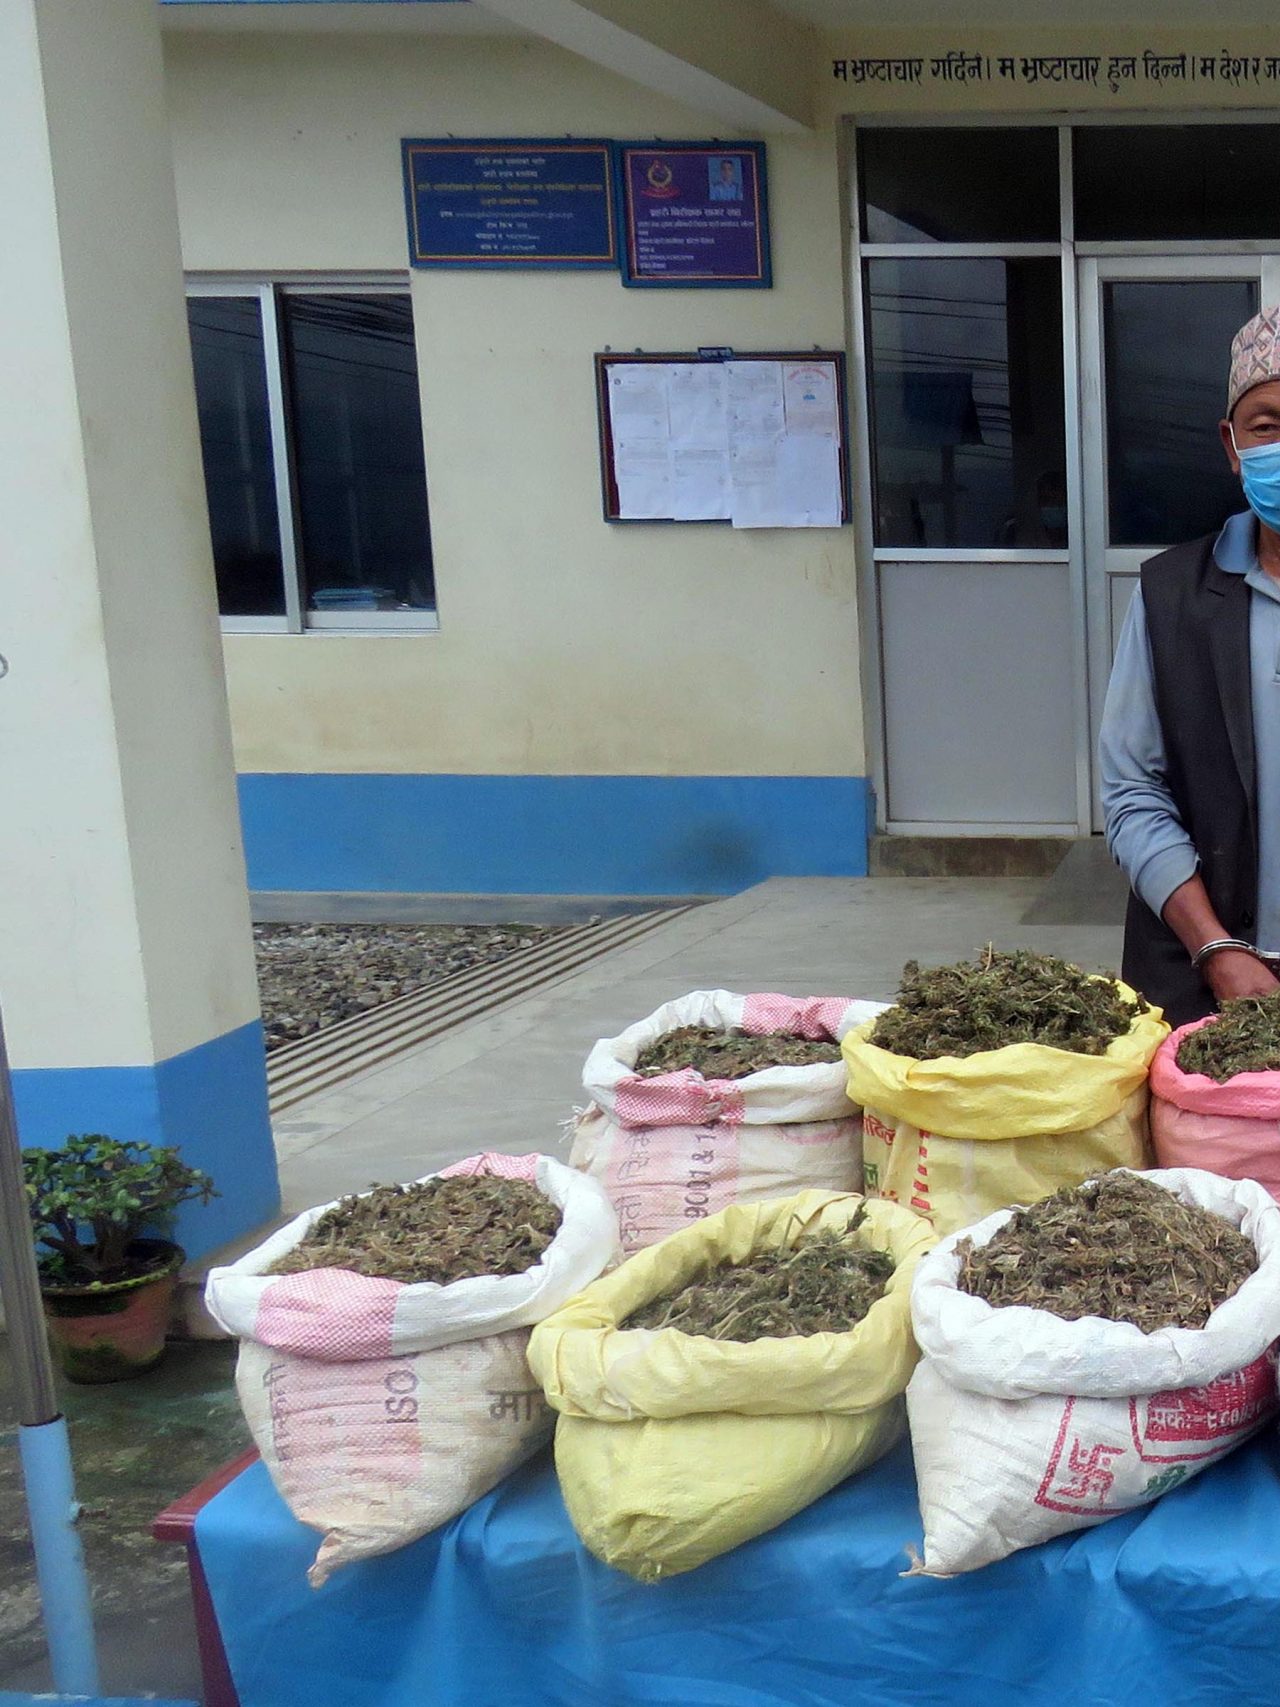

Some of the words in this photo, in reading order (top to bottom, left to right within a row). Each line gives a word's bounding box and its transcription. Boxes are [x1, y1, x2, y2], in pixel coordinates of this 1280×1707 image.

[832, 59, 848, 82] म
[1220, 49, 1249, 87] देश
[692, 1150, 715, 1165] &
[684, 1169, 713, 1219] 9001
[384, 1369, 419, 1424] ISO
